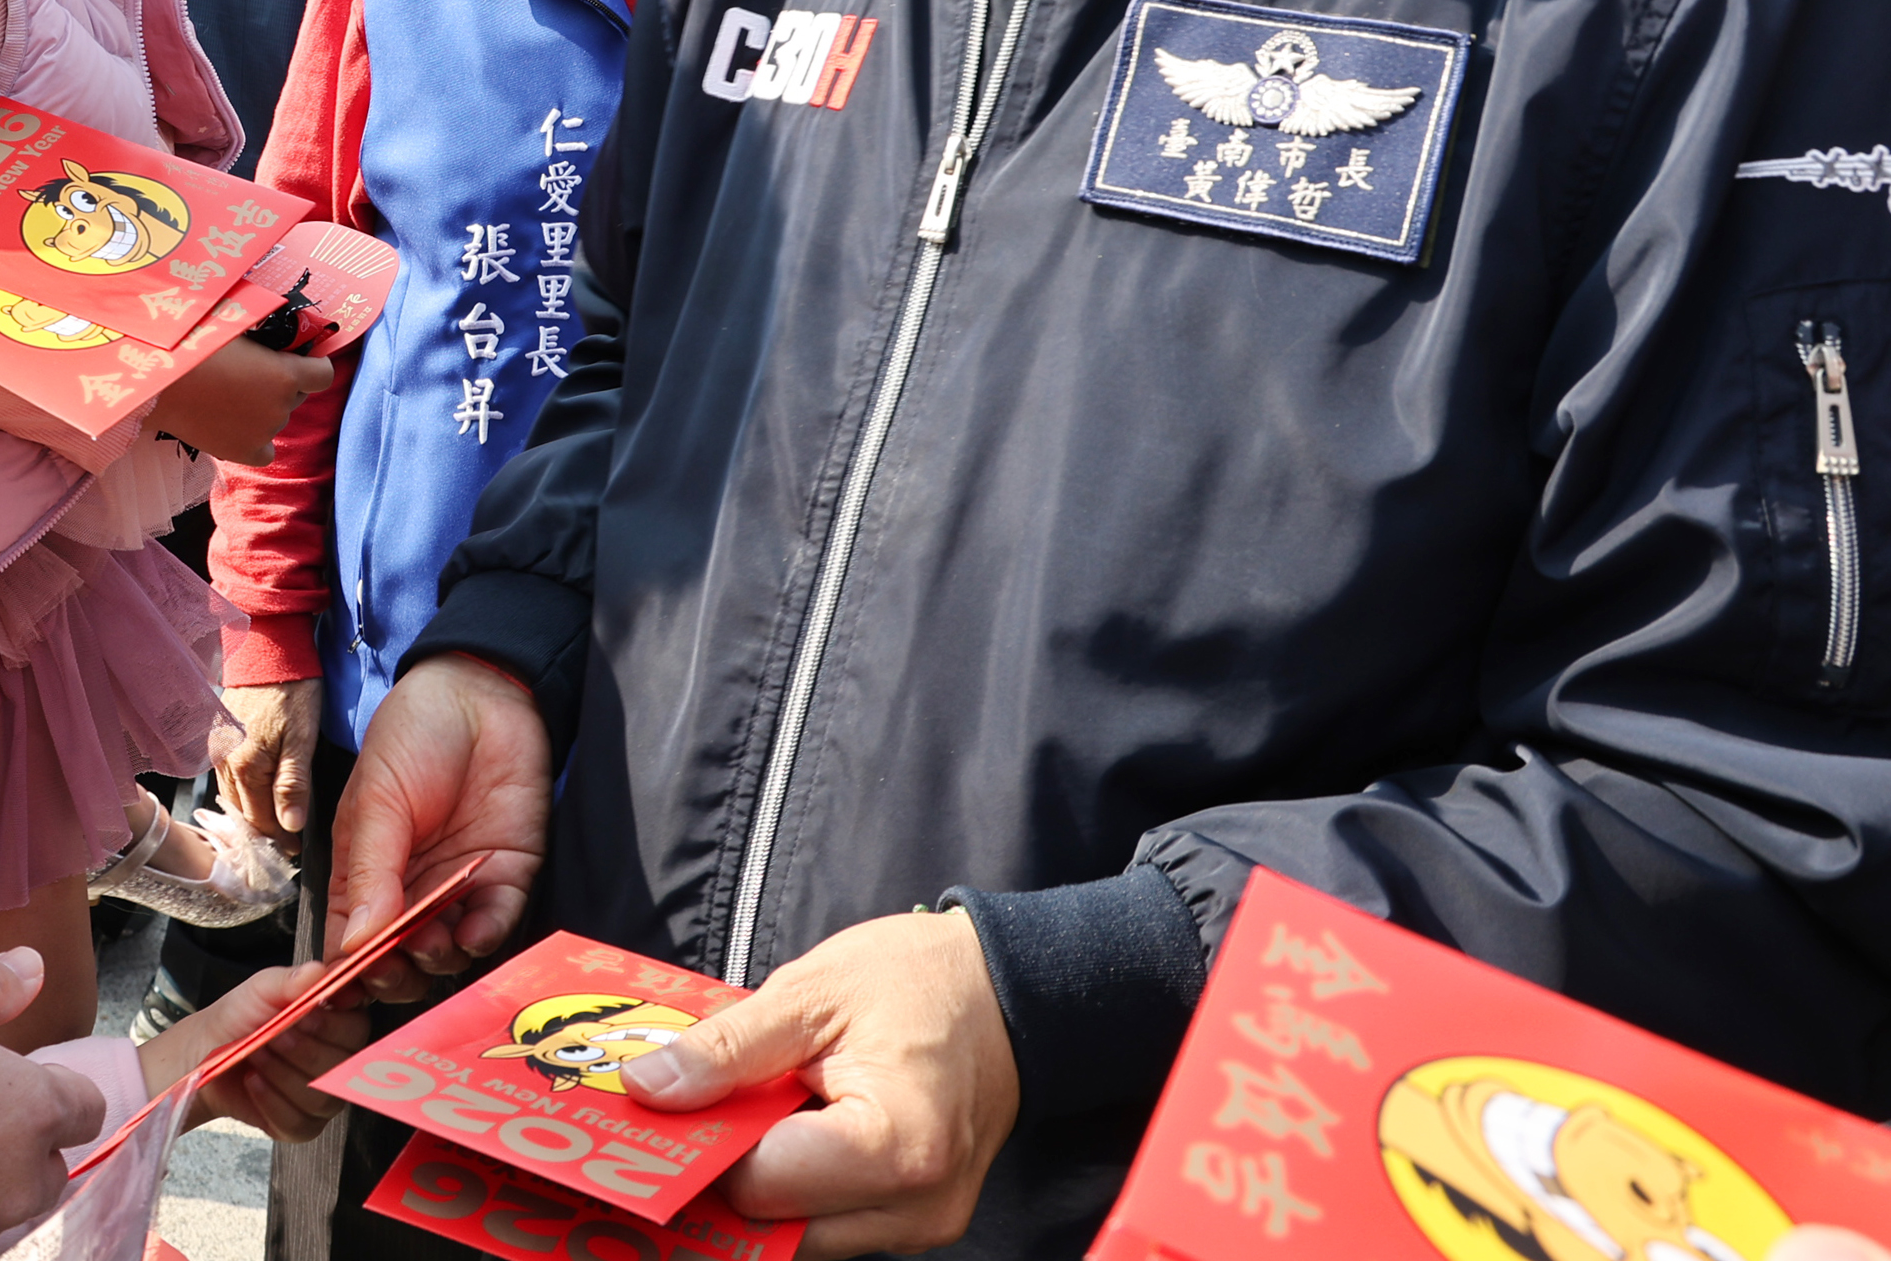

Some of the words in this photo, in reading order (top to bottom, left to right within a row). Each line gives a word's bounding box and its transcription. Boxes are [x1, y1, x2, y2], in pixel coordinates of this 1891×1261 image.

[17, 124, 67, 159] Year
[1158, 118, 1374, 191] 臺南市長
[1183, 160, 1333, 221] 黃偉哲
[138, 199, 280, 320] 金馬伍吉
[525, 107, 589, 380] 仁愛里里長
[453, 223, 521, 445] 張台昇
[394, 1046, 476, 1084] Year
[483, 1077, 564, 1112] New
[345, 1059, 686, 1199] 2026
[571, 1106, 703, 1172] Happy
